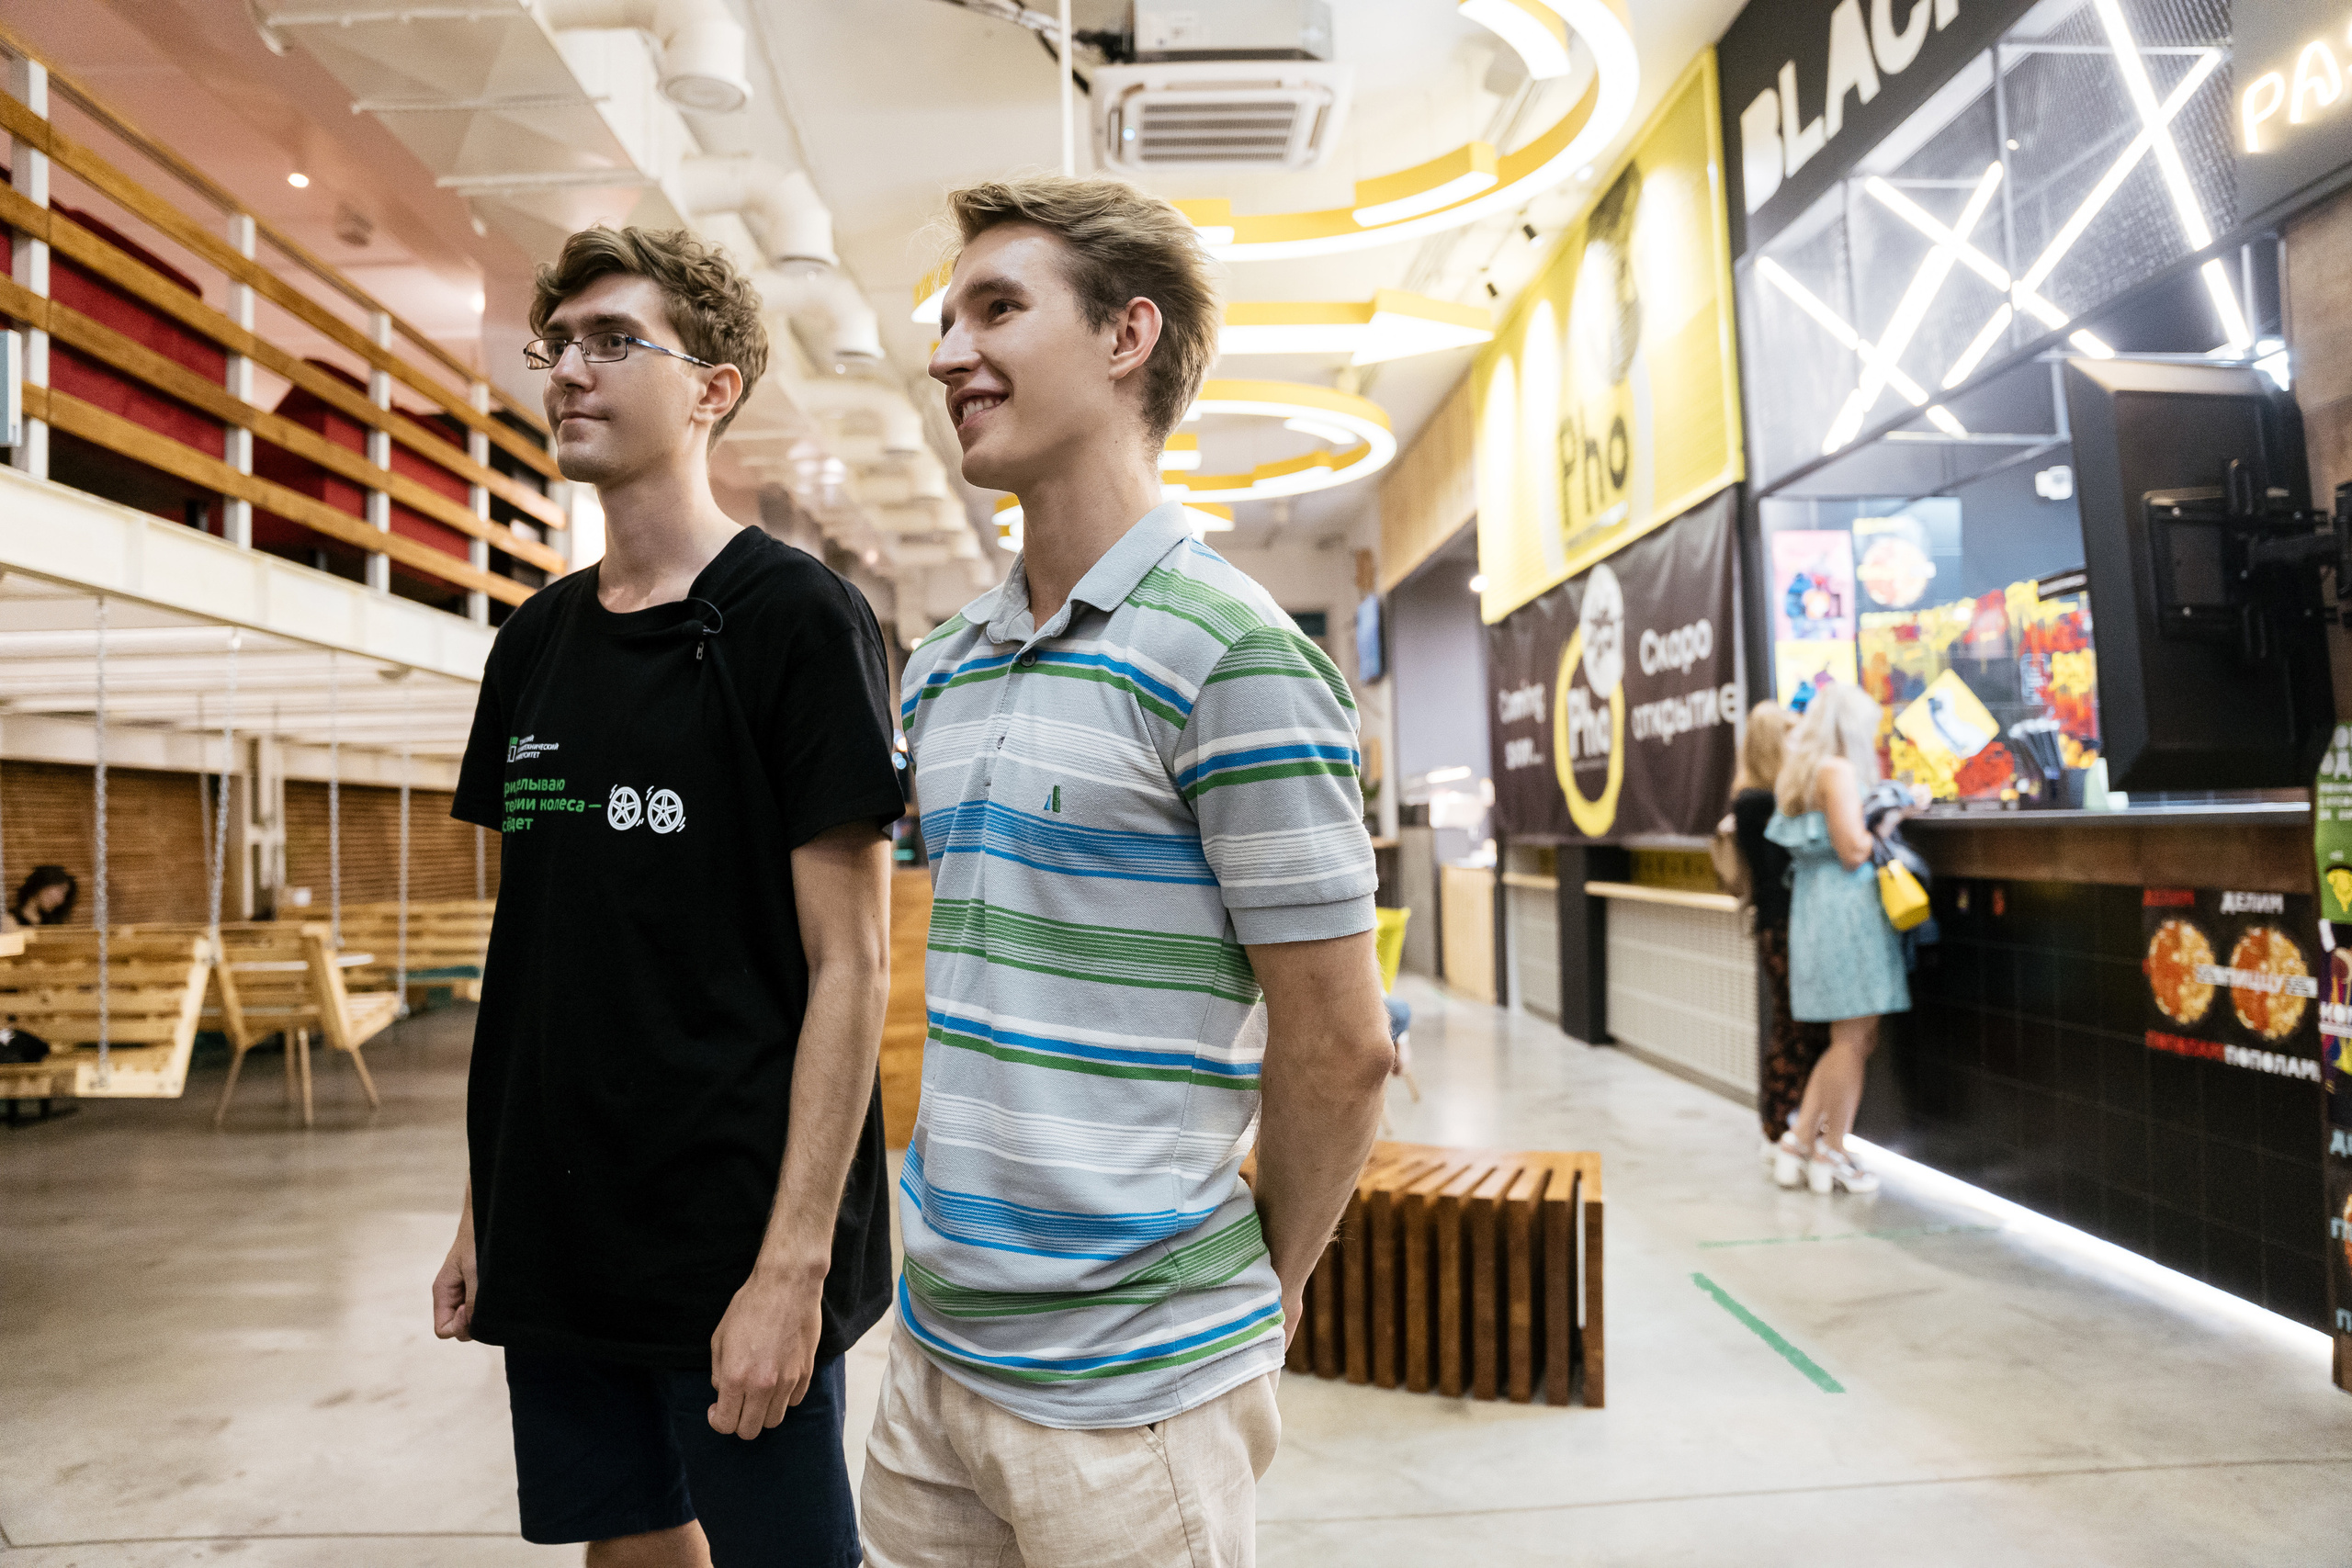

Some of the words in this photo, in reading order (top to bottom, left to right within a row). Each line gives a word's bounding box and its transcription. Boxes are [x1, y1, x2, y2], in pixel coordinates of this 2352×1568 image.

[1740, 0, 1960, 215] BLAC
[2243, 18, 2352, 153] PA
[1559, 404, 1629, 528] Pho
[1639, 618, 1713, 676] Скоро
[1567, 686, 1611, 761] Pho
[1631, 682, 1742, 746] открытие
[517, 742, 559, 753] ТЕХНИЧЕСКИЙ
[539, 798, 585, 813] колеса
[2220, 890, 2284, 915] ДЕЛИМ
[2224, 1044, 2322, 1083] ПОПОЛАМ
